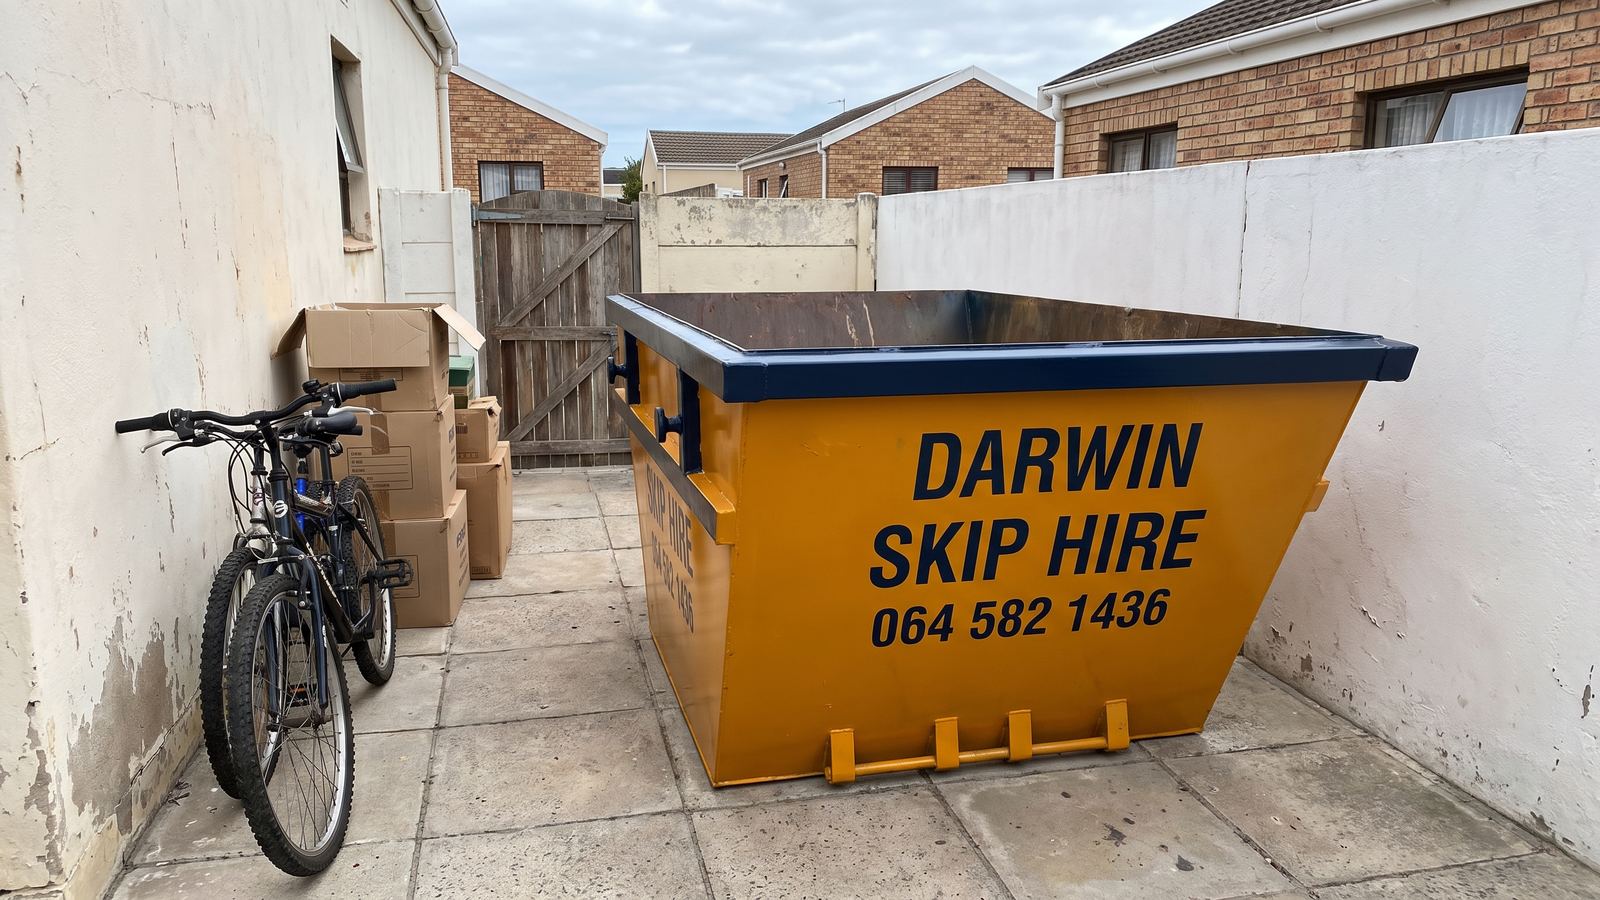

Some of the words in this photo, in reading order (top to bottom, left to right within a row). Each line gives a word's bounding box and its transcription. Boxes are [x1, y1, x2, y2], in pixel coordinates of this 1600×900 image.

[912, 422, 1204, 501] DARWIN
[647, 463, 666, 532] SKIP
[668, 491, 693, 578] HIRE
[869, 517, 1030, 589] SKIP
[1046, 509, 1207, 577] HIRE
[676, 572, 694, 633] 1436
[871, 603, 955, 648] 064
[969, 596, 1053, 640] 582
[1068, 588, 1171, 632] 1436
